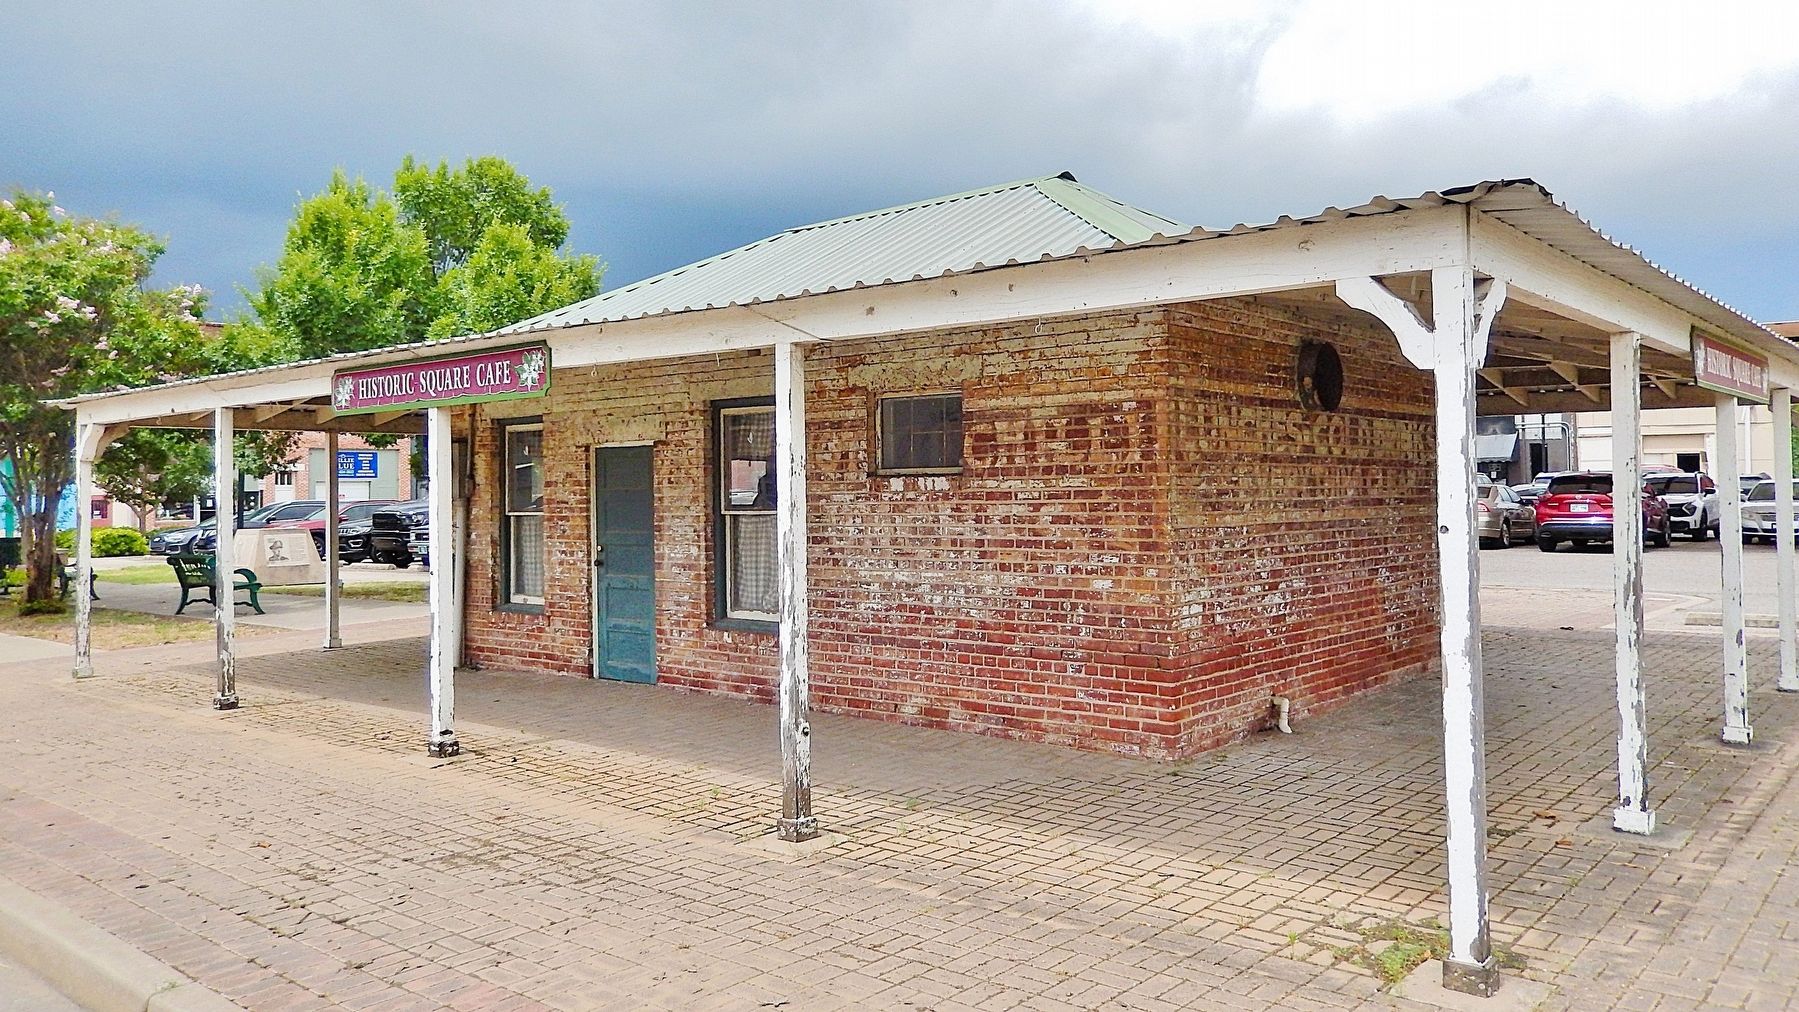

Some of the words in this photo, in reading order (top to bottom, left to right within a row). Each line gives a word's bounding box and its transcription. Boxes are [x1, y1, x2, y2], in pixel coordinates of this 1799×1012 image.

[358, 372, 415, 400] HISTORIC
[419, 365, 471, 397] SQUARE
[476, 360, 511, 387] CAFE
